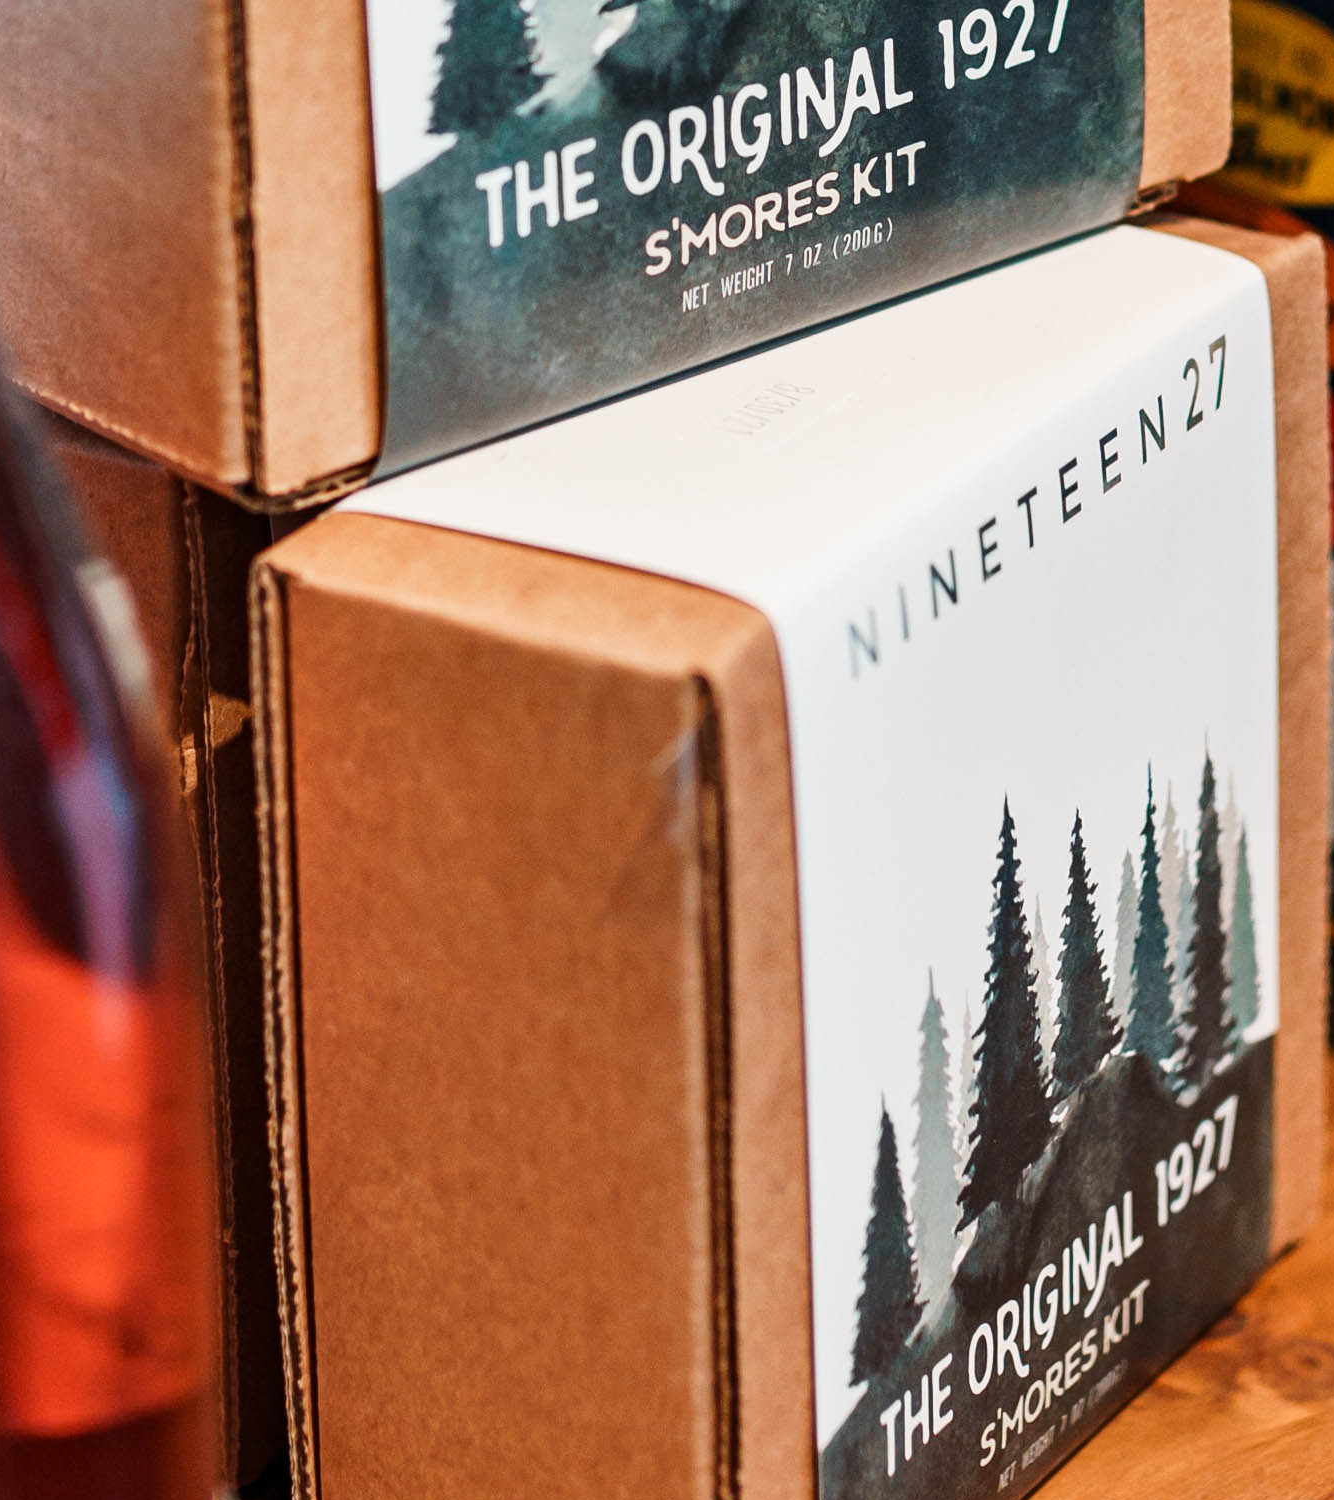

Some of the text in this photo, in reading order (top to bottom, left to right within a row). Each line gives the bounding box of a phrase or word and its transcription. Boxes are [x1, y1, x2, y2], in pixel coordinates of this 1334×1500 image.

[474, 138, 600, 248] THE
[620, 37, 915, 198] ORIGINAL
[643, 140, 928, 277] S'MORES KIT
[681, 281, 711, 314] NET
[720, 258, 776, 300] WEIGHT
[784, 252, 794, 277] 7
[802, 242, 823, 271] OZ
[879, 1094, 1240, 1479] THE ORIGINAL 1927
[978, 1327, 1099, 1468] S'MORES
[1101, 1278, 1151, 1356] KIT
